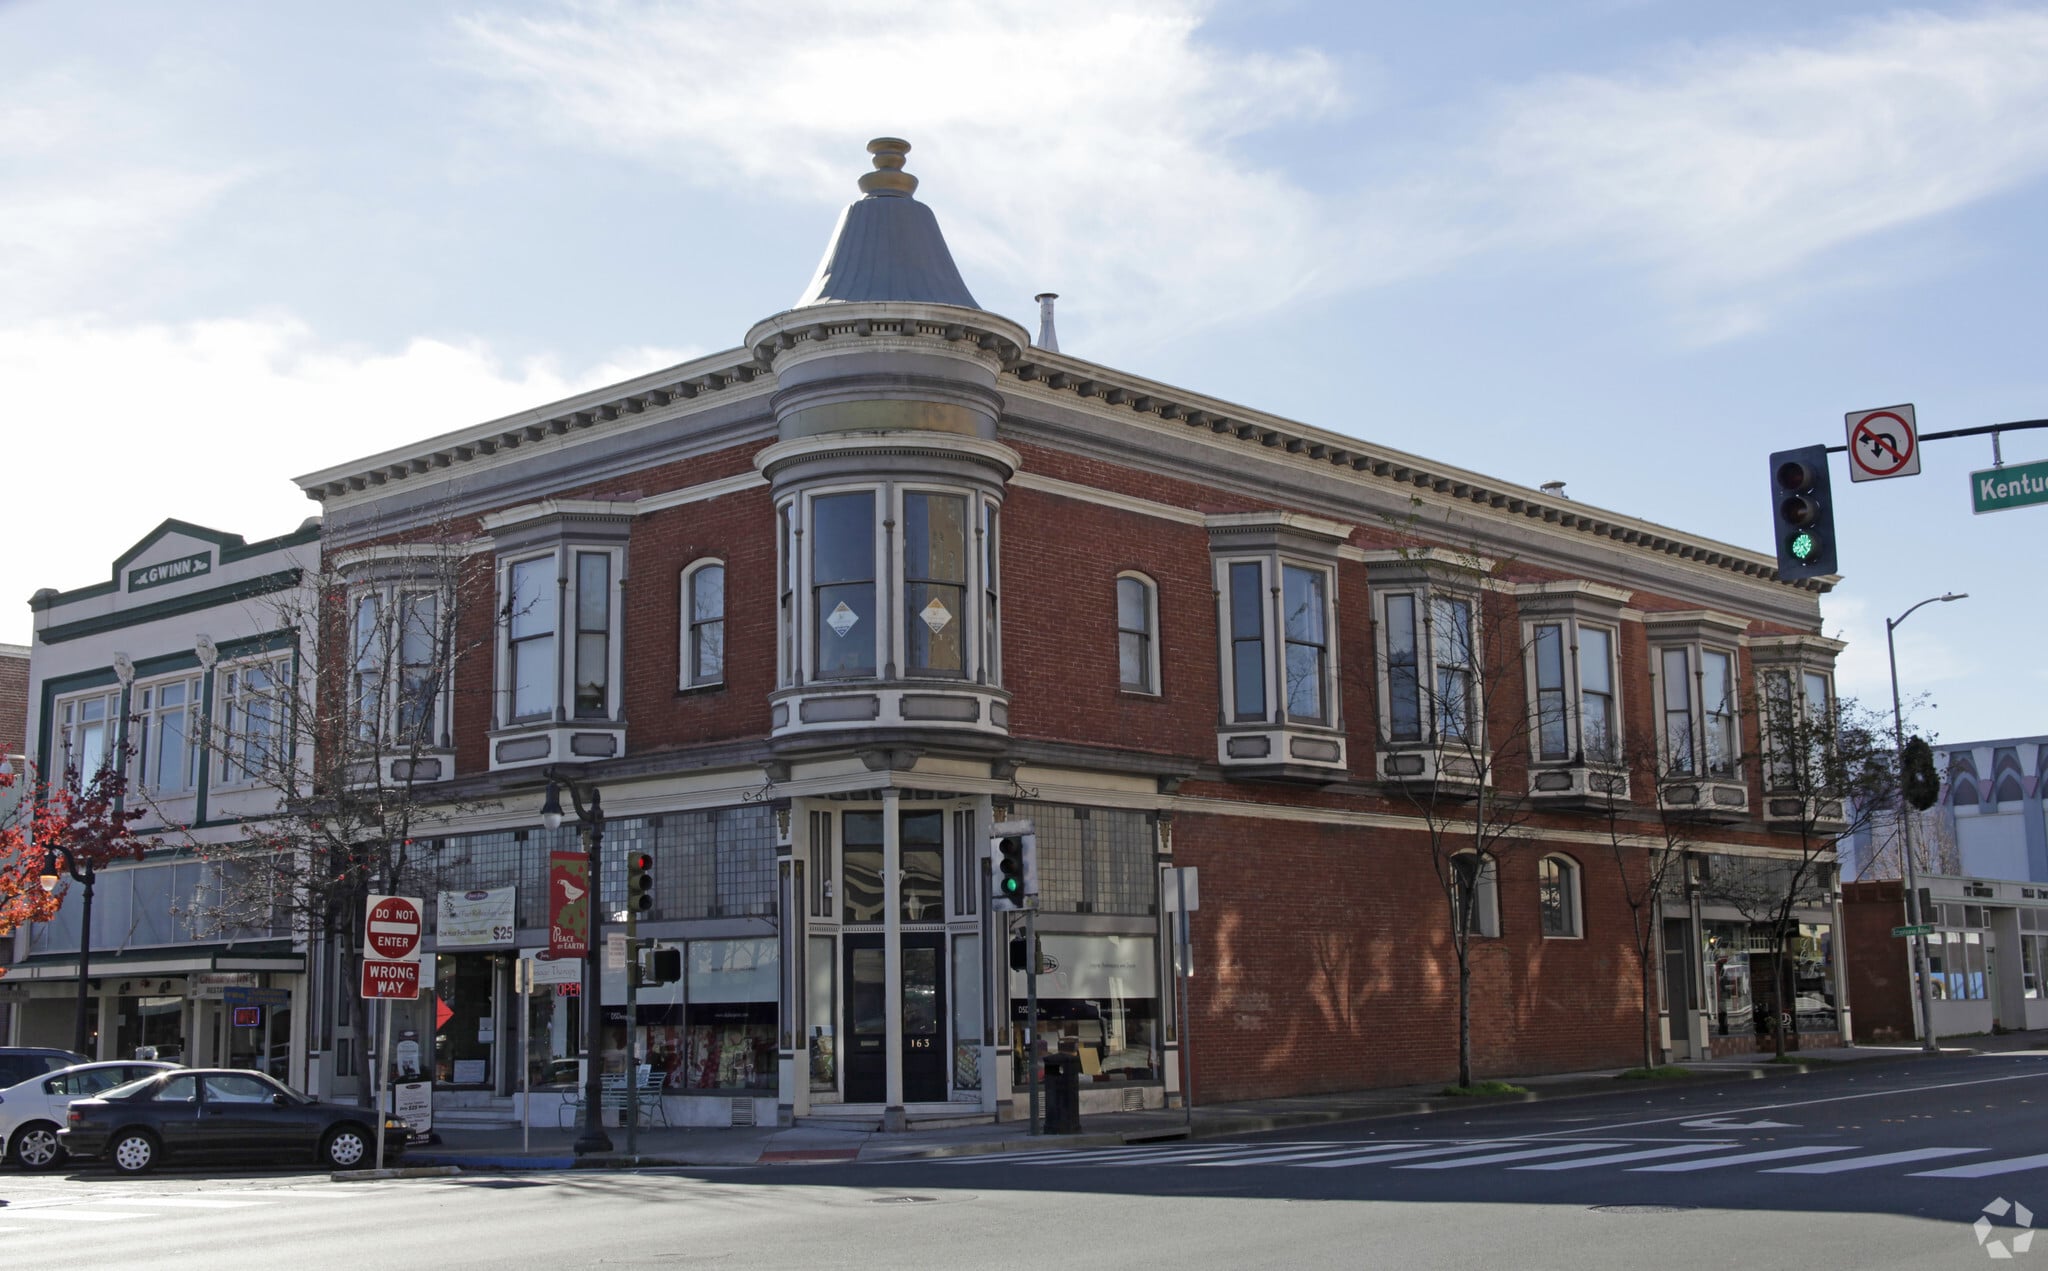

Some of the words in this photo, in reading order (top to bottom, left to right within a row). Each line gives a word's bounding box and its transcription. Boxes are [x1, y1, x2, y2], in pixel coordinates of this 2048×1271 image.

[149, 560, 191, 581] GWINN
[376, 908, 389, 919] DO
[396, 910, 415, 920] NOT
[493, 926, 513, 941] $25
[378, 936, 408, 948] ENTER
[564, 942, 585, 950] EARTH
[370, 965, 413, 979] WRONG
[378, 981, 404, 994] WAY
[911, 1039, 930, 1048] 163
